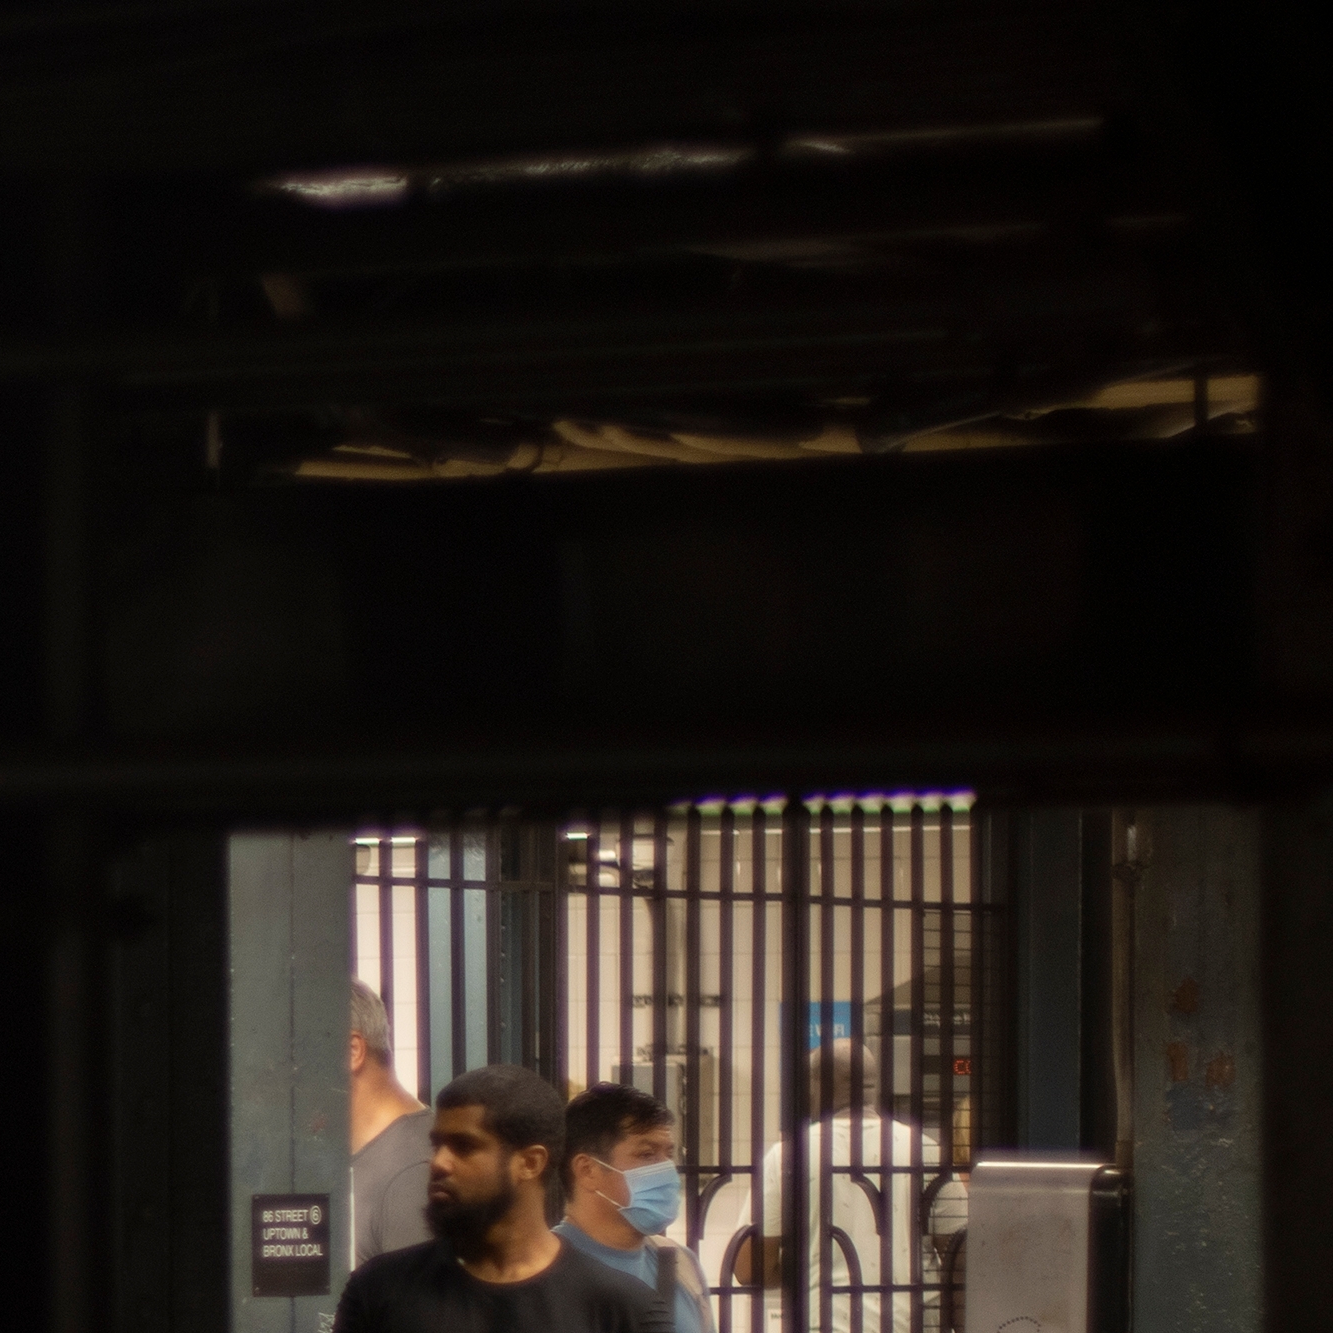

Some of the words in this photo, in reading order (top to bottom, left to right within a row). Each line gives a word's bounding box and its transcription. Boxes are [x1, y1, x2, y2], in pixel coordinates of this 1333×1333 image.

[263, 1210, 274, 1222] 86
[275, 1209, 308, 1222] STREET
[263, 1227, 301, 1240] UPTOWN
[263, 1245, 294, 1257] BRONX
[296, 1244, 323, 1256] LOCAL
